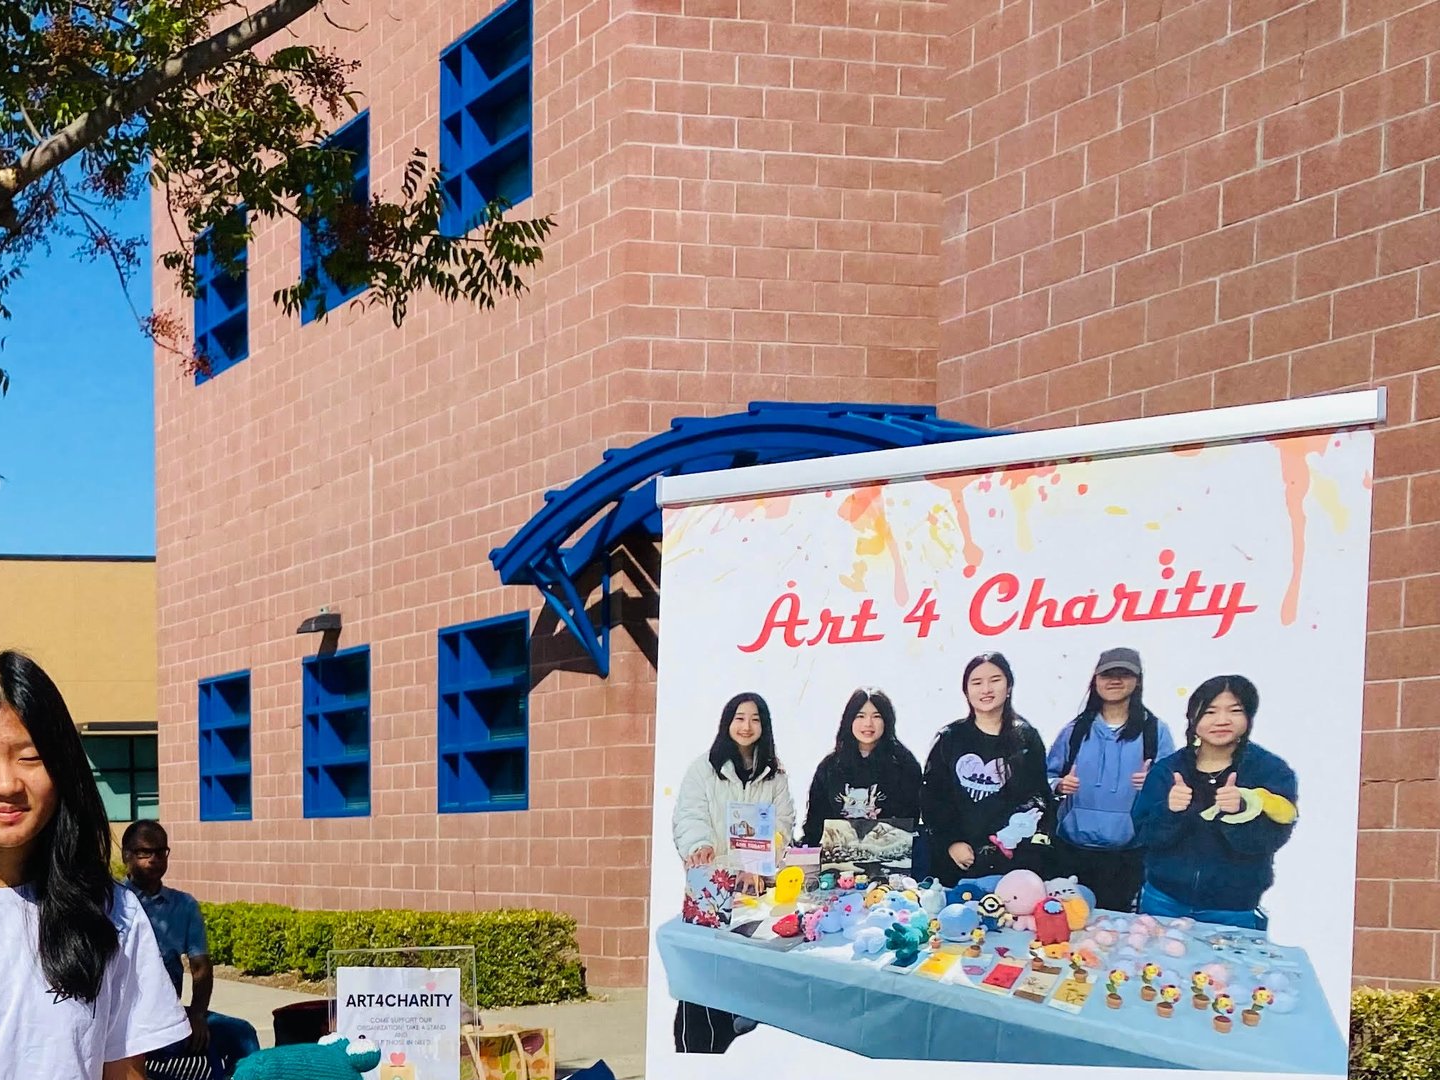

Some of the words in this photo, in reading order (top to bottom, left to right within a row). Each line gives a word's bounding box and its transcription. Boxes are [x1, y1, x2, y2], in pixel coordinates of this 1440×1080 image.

[737, 593, 885, 652] Art
[903, 588, 940, 637] 4
[969, 566, 1258, 638] Charity
[346, 994, 453, 1007] ART4CHARITY
